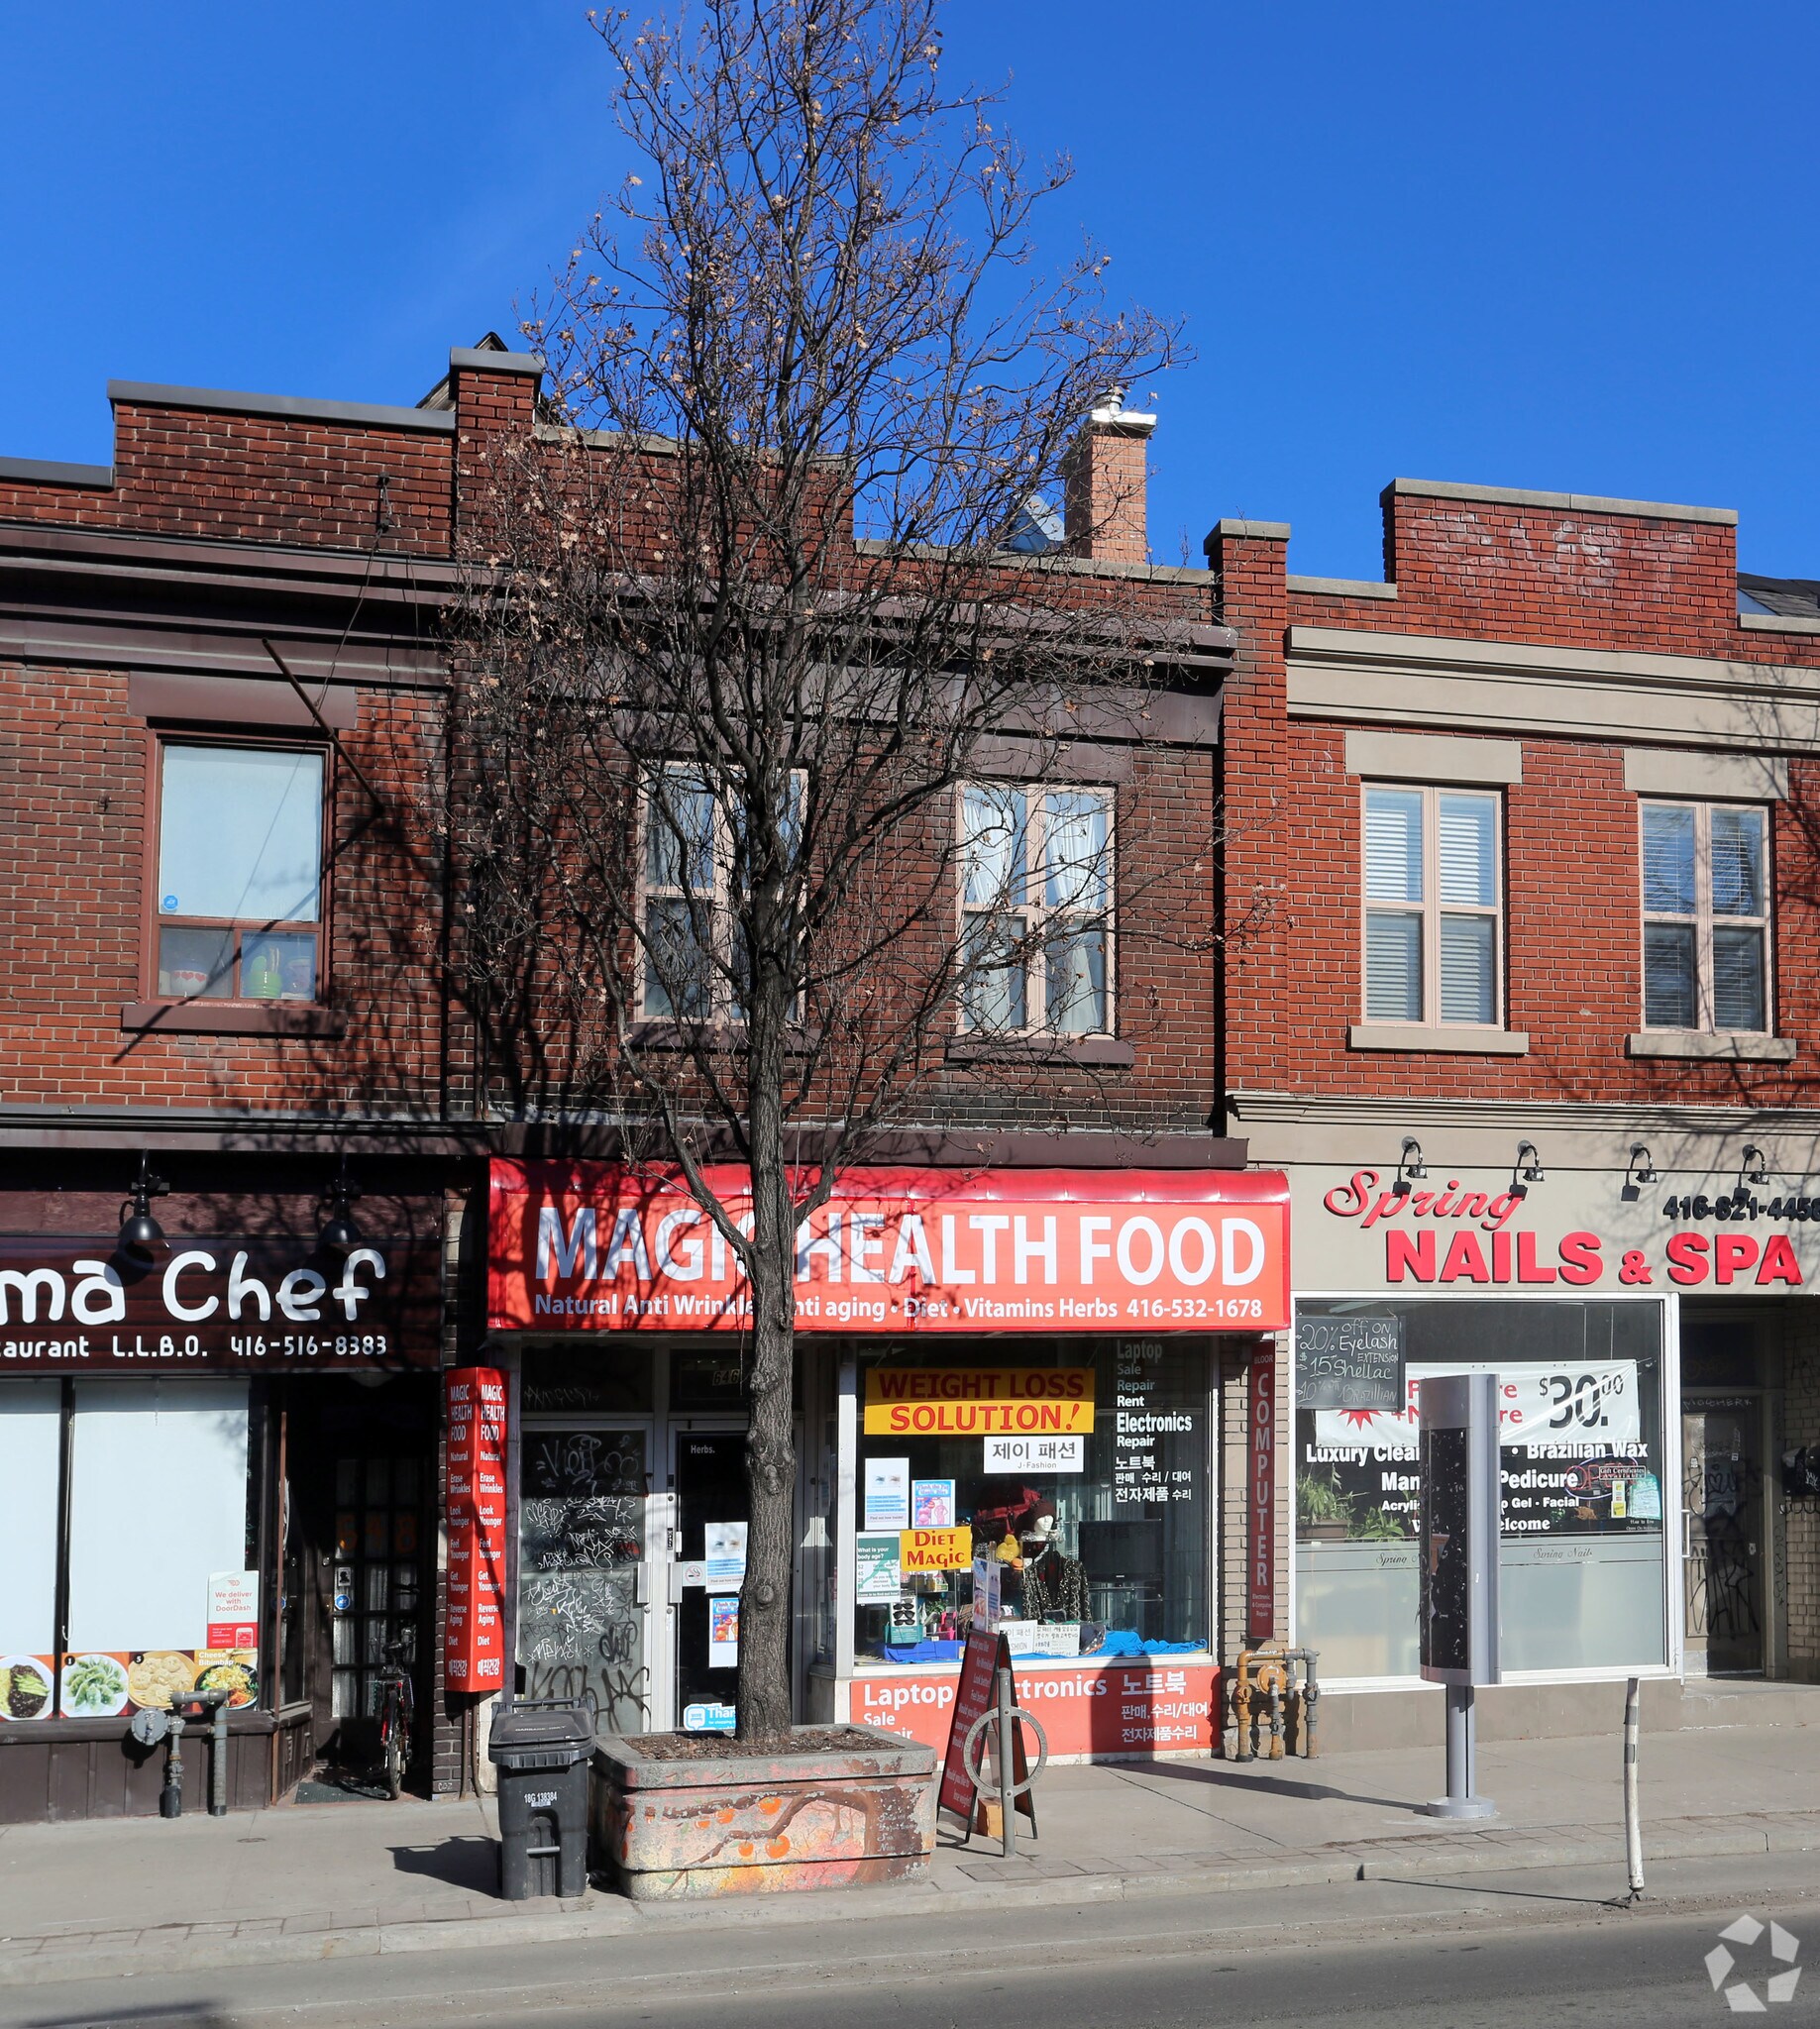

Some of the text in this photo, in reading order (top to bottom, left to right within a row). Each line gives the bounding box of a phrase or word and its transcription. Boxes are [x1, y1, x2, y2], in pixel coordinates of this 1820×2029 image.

[1324, 1169, 1527, 1230] Spring
[794, 1211, 1056, 1285] HEALTH
[1080, 1216, 1265, 1287] FOOD
[1385, 1229, 1804, 1286] NAILS & SPA
[162, 1248, 387, 1323] Chef
[535, 1293, 617, 1316] Natural
[623, 1294, 669, 1316] Anti
[674, 1294, 755, 1317] Wrinkle
[825, 1298, 885, 1323] aging
[904, 1298, 947, 1319] Diet
[964, 1297, 1053, 1319] Vitamins
[1059, 1297, 1118, 1319] Herbs
[1126, 1299, 1262, 1319] 416-532-1678
[0, 1335, 387, 1358] aurant L.L.B.O. 416-516-8383
[1117, 1338, 1162, 1363] Laptop
[1339, 1333, 1398, 1356] Eyelash
[713, 1369, 739, 1385] 646
[1118, 1363, 1141, 1375] Sale
[1334, 1358, 1393, 1379] Shellac
[481, 1384, 503, 1402] MAGIC
[879, 1373, 1084, 1399] WEIGHT LOSS
[1118, 1379, 1155, 1393] Repair
[1117, 1395, 1144, 1407] Rent
[481, 1405, 505, 1422] HEALTH
[890, 1403, 1080, 1431] SOLUTION!
[1117, 1411, 1193, 1433] Electronics
[451, 1425, 467, 1442] FOOD
[481, 1425, 499, 1441] FOOD
[691, 1444, 715, 1454] Herbs.
[1117, 1435, 1155, 1449] Repair
[481, 1450, 500, 1461] Natural
[993, 1442, 1076, 1460] 제이 패션
[1307, 1443, 1368, 1467] Luxury
[1527, 1442, 1606, 1459] Brazilian
[1611, 1442, 1649, 1457] Wax
[1115, 1455, 1155, 1470] 노트북
[480, 1472, 495, 1482] Erase
[1115, 1472, 1134, 1484] 판매
[1141, 1471, 1161, 1483] 수리
[1172, 1470, 1191, 1483] 대여
[1500, 1470, 1578, 1489] Pedicure
[1115, 1486, 1192, 1503] 전자제품 수리
[1512, 1497, 1532, 1508] Gel
[1543, 1497, 1579, 1508] Facial
[480, 1505, 493, 1515] Look
[480, 1516, 502, 1528] Younger
[1500, 1518, 1551, 1531] elcome
[479, 1570, 488, 1580] Get
[478, 1636, 490, 1646] Diet
[198, 1658, 234, 1667] Bibimbap
[1122, 1671, 1187, 1695] 노트북
[864, 1683, 953, 1710] Laptop
[863, 1712, 895, 1727] Sale
